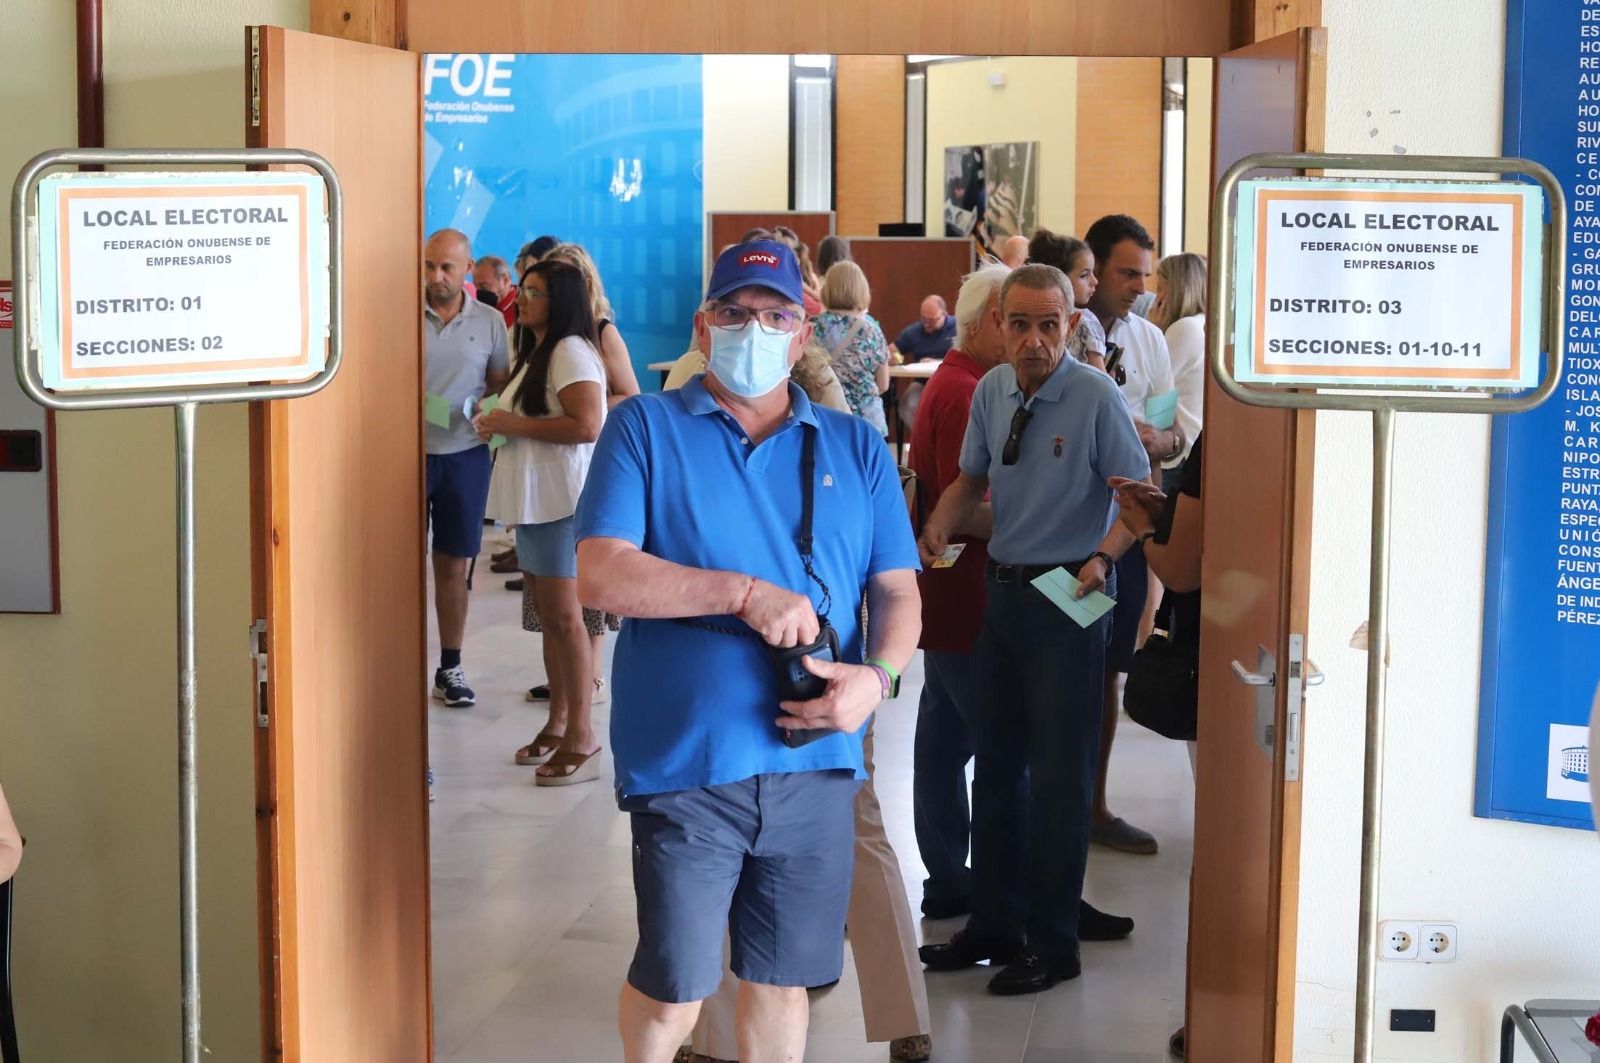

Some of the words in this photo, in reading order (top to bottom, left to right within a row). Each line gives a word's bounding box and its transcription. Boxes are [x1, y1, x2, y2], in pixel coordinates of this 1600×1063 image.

[1581, 25, 1599, 37] ES
[1580, 41, 1600, 53] HO
[1580, 57, 1599, 69] RE
[424, 53, 516, 97] FOE
[1578, 105, 1599, 117] HO
[1577, 121, 1600, 133] SU
[1577, 137, 1600, 149] RIV
[1574, 200, 1595, 212] DE
[83, 209, 158, 227] LOCAL
[164, 207, 288, 226] ELECTORAL
[1281, 212, 1356, 229] LOCAL
[1364, 213, 1499, 232] ELECTORAL
[1573, 216, 1600, 228] AYA
[103, 236, 184, 250] FEDERACIÓN
[187, 237, 252, 249] ONUBENSE
[256, 236, 271, 246] DE
[1300, 240, 1382, 253] FEDERACIÓN
[1386, 243, 1458, 254] ONUBENSE
[1462, 244, 1479, 254] DE
[146, 254, 232, 266] EMPRESARIOS
[1343, 259, 1435, 271] EMPRESARIOS
[76, 297, 175, 315] DISTRITO:
[181, 296, 202, 311] 01
[1269, 298, 1372, 315] DISTRITO:
[1378, 300, 1402, 315] 03
[1570, 295, 1600, 307] GON
[76, 337, 195, 356] SECCIONES:
[201, 335, 223, 350] 02
[1269, 339, 1392, 355] SECCIONES:
[1399, 341, 1482, 357] 01-10-11
[1567, 357, 1600, 370] TIOX
[1566, 388, 1600, 401] ISLA
[1565, 420, 1580, 432] M.
[1590, 421, 1600, 433] K
[1564, 436, 1598, 449] CAR
[1563, 451, 1600, 464] NIPO
[1562, 467, 1600, 480] ESTR
[1558, 544, 1600, 558] CONS
[1557, 573, 1600, 591] ÁNGE
[1557, 594, 1576, 607] DE
